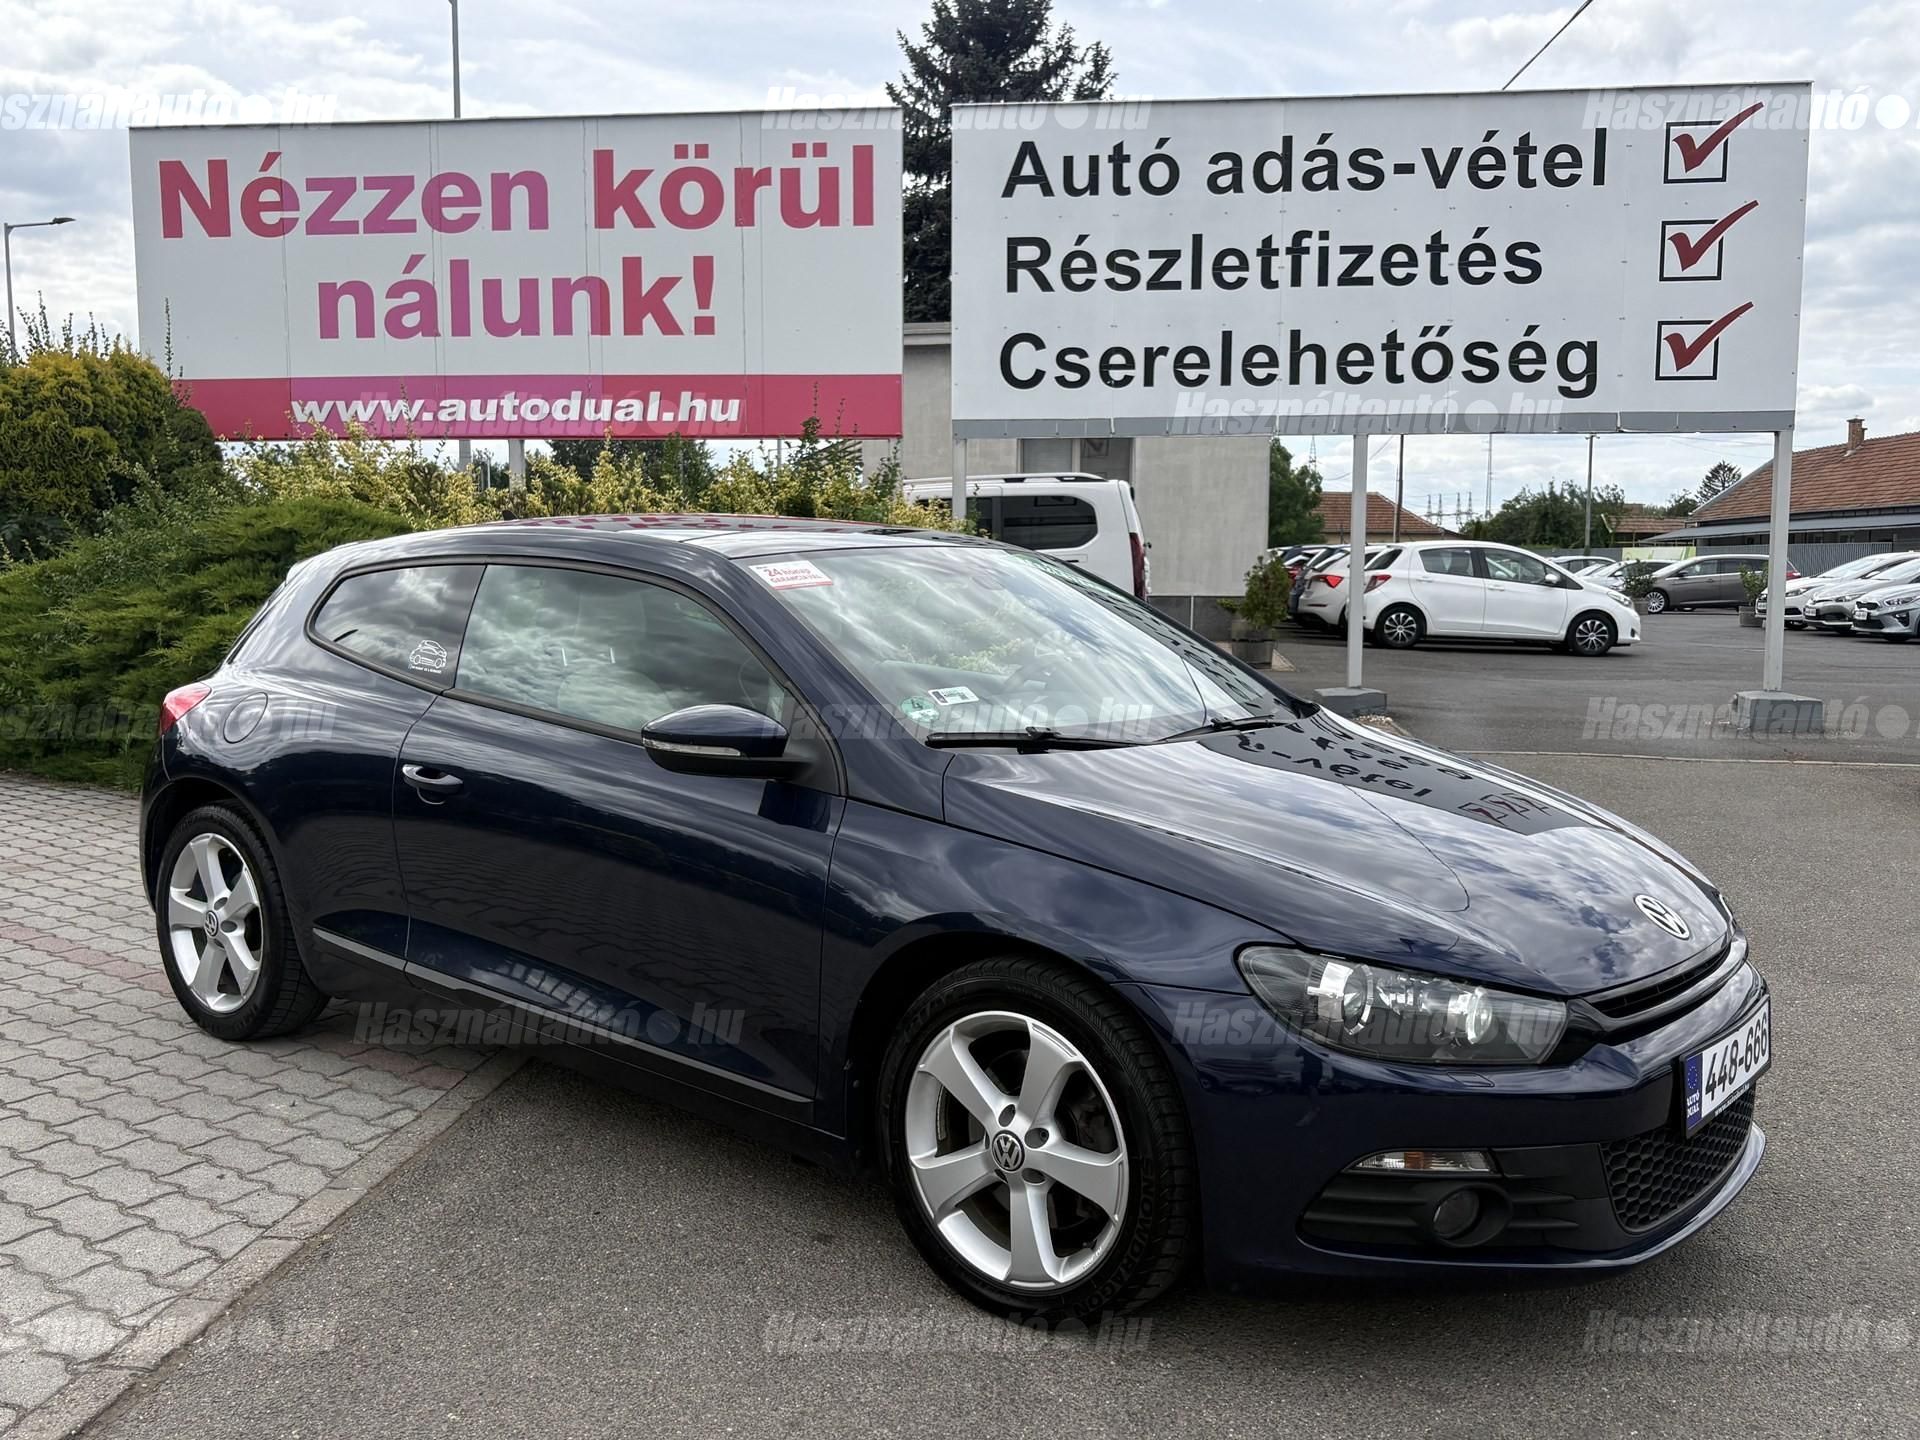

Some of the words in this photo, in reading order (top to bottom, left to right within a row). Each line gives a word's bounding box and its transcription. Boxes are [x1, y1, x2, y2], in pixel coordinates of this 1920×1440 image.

[160, 152, 548, 238] Nézzen
[595, 143, 873, 229] körül
[1001, 138, 1180, 198] Autó
[1206, 127, 1607, 195] adás-vétel
[319, 255, 715, 339] nálunk!
[1006, 227, 1543, 293] Részletfizetés
[1000, 324, 1598, 399] Cserelehetőség
[291, 391, 740, 422] www.autodual.hu
[1705, 1012, 1768, 1102] 448-666
